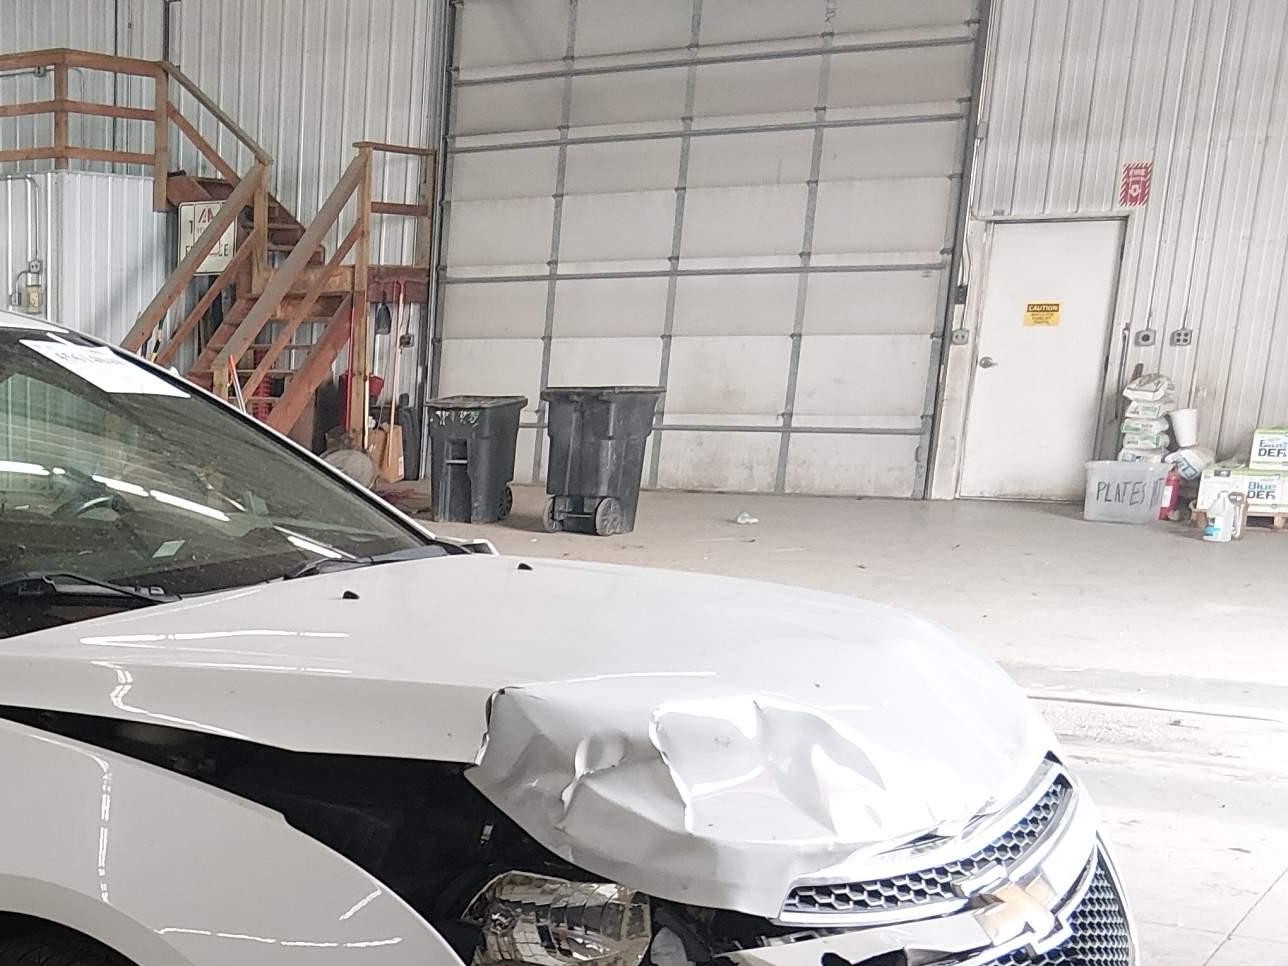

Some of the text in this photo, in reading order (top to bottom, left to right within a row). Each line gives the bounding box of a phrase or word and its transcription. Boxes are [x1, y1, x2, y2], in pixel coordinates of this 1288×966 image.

[1258, 448, 1286, 457] DEF
[1248, 481, 1277, 490] Blue
[1096, 480, 1147, 506] PLATES
[1247, 490, 1276, 500] DEF
